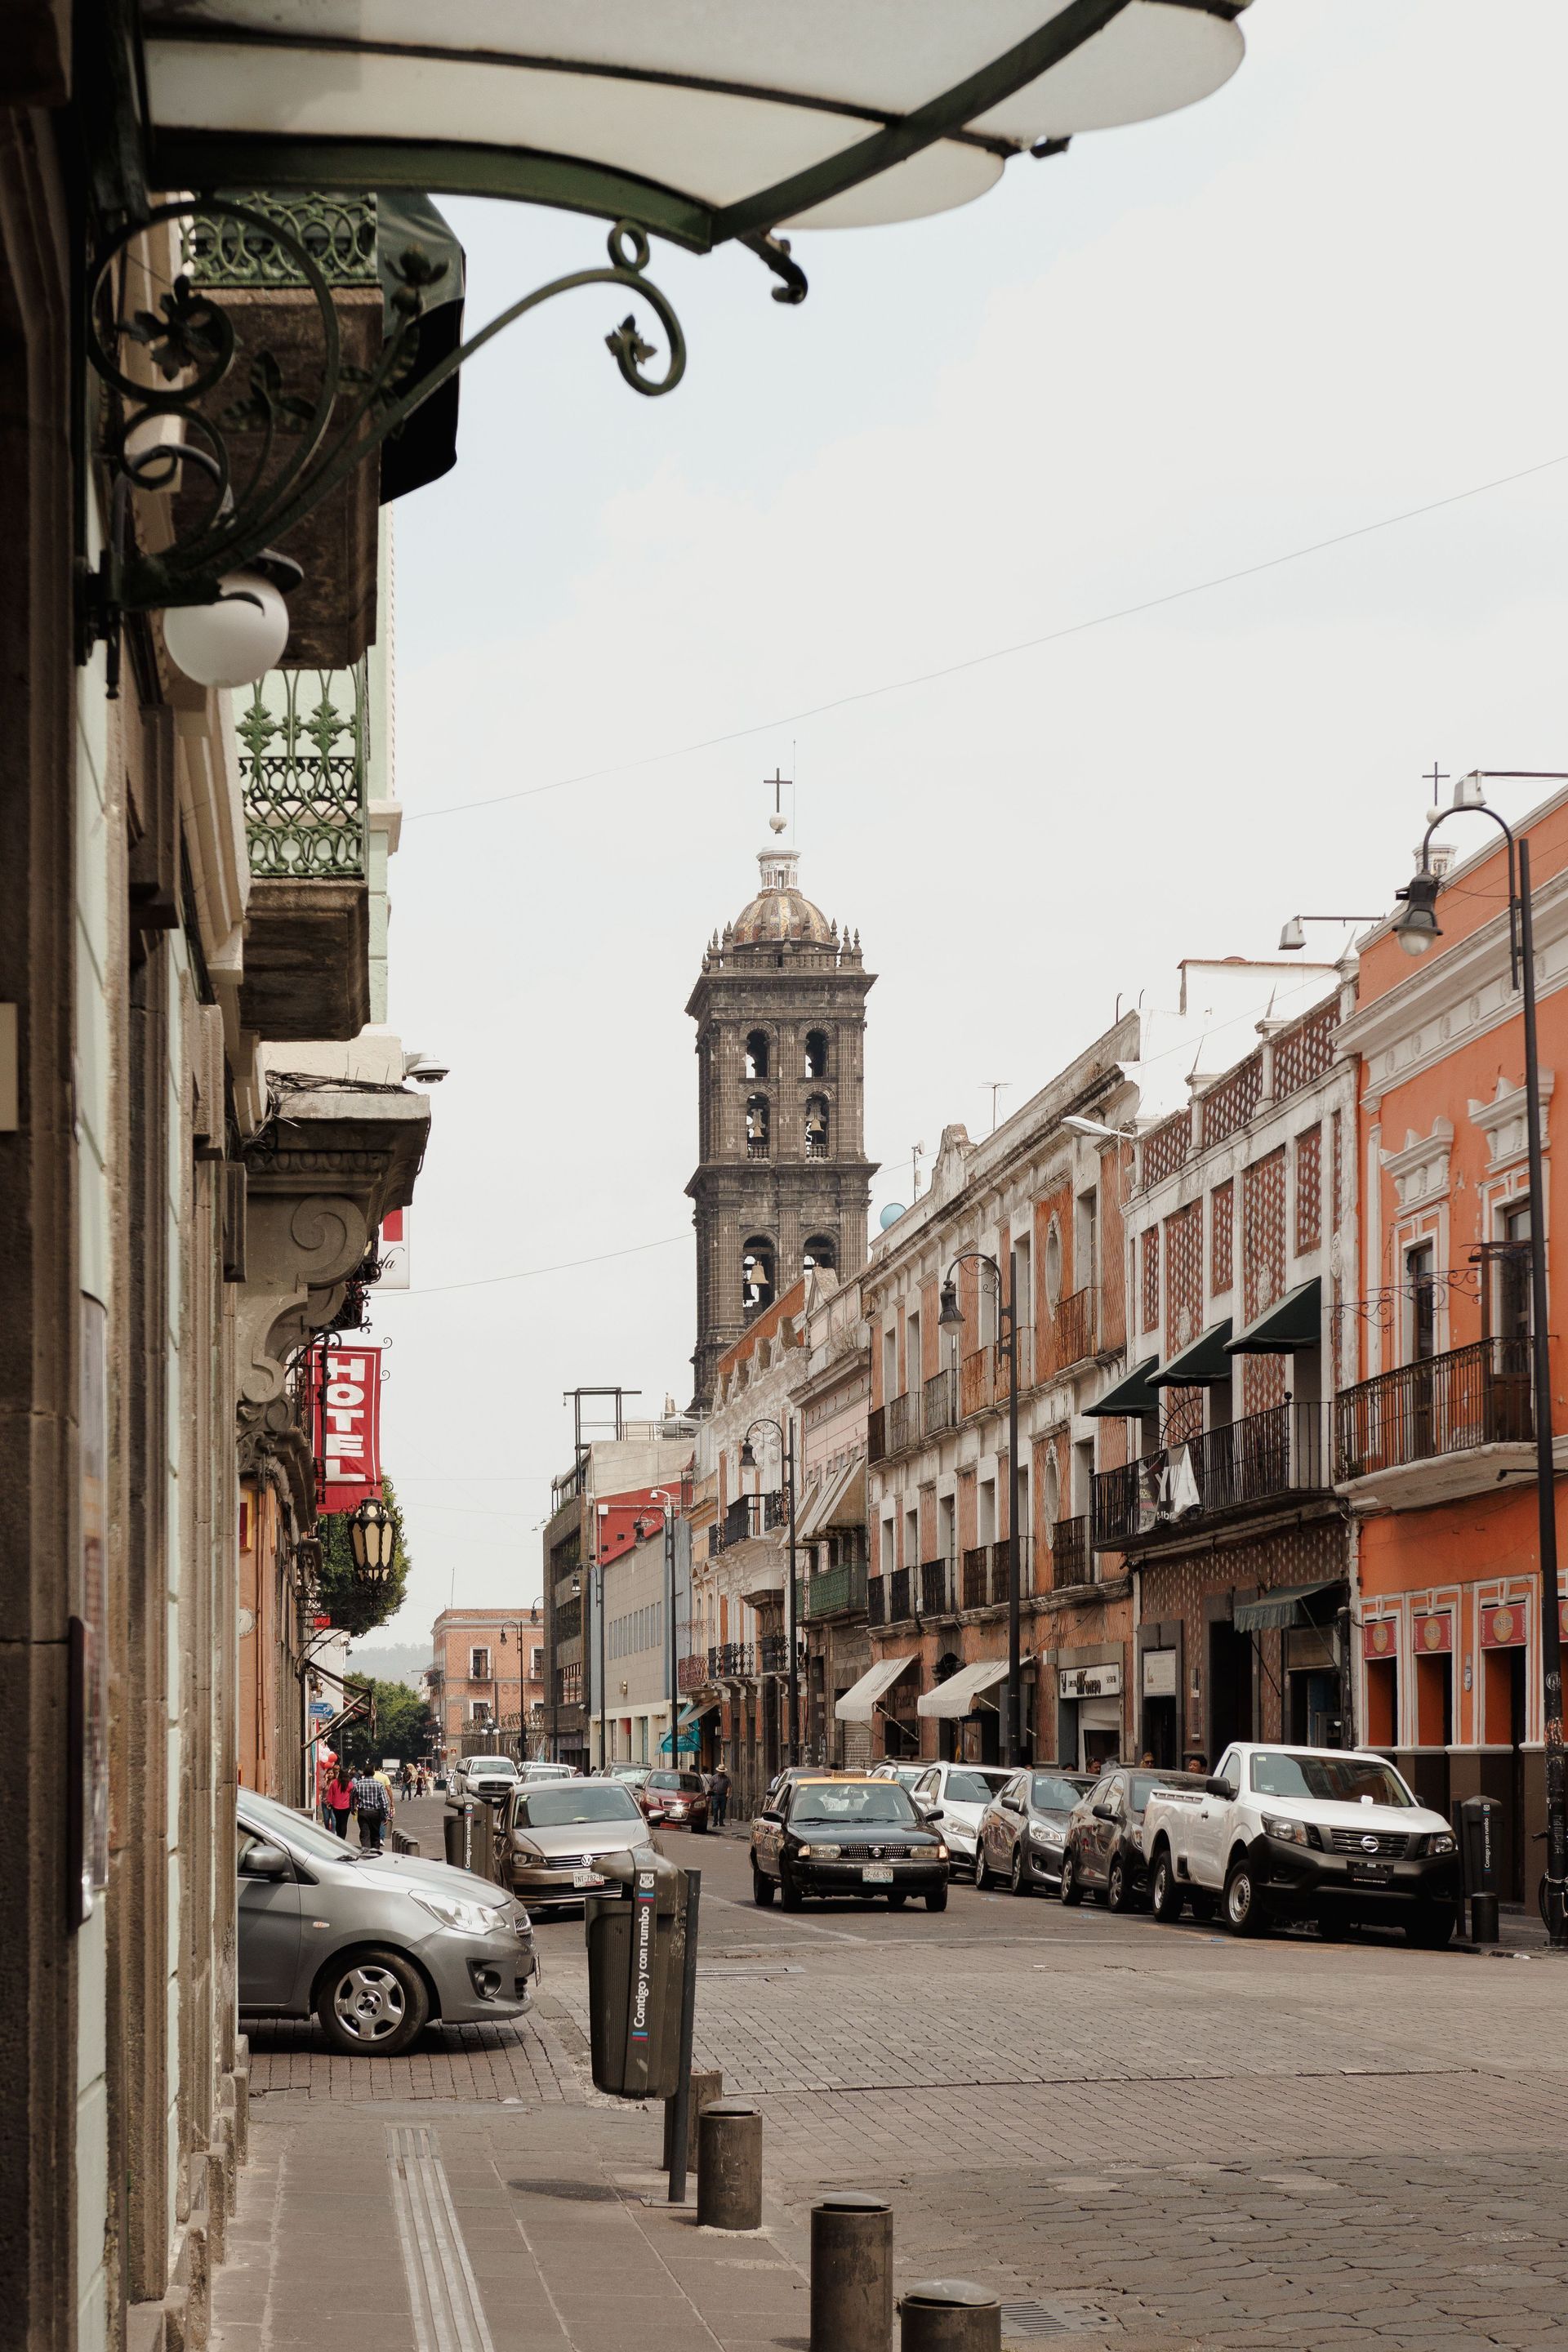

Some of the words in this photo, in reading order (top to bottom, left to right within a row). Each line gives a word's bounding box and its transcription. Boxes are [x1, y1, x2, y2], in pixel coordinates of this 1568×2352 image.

[326, 1357, 366, 1482] HOTEL
[639, 1906, 649, 1946] rumbo
[639, 1948, 648, 1970] con
[639, 1971, 649, 1979] y
[634, 1981, 649, 2028] Contigo
